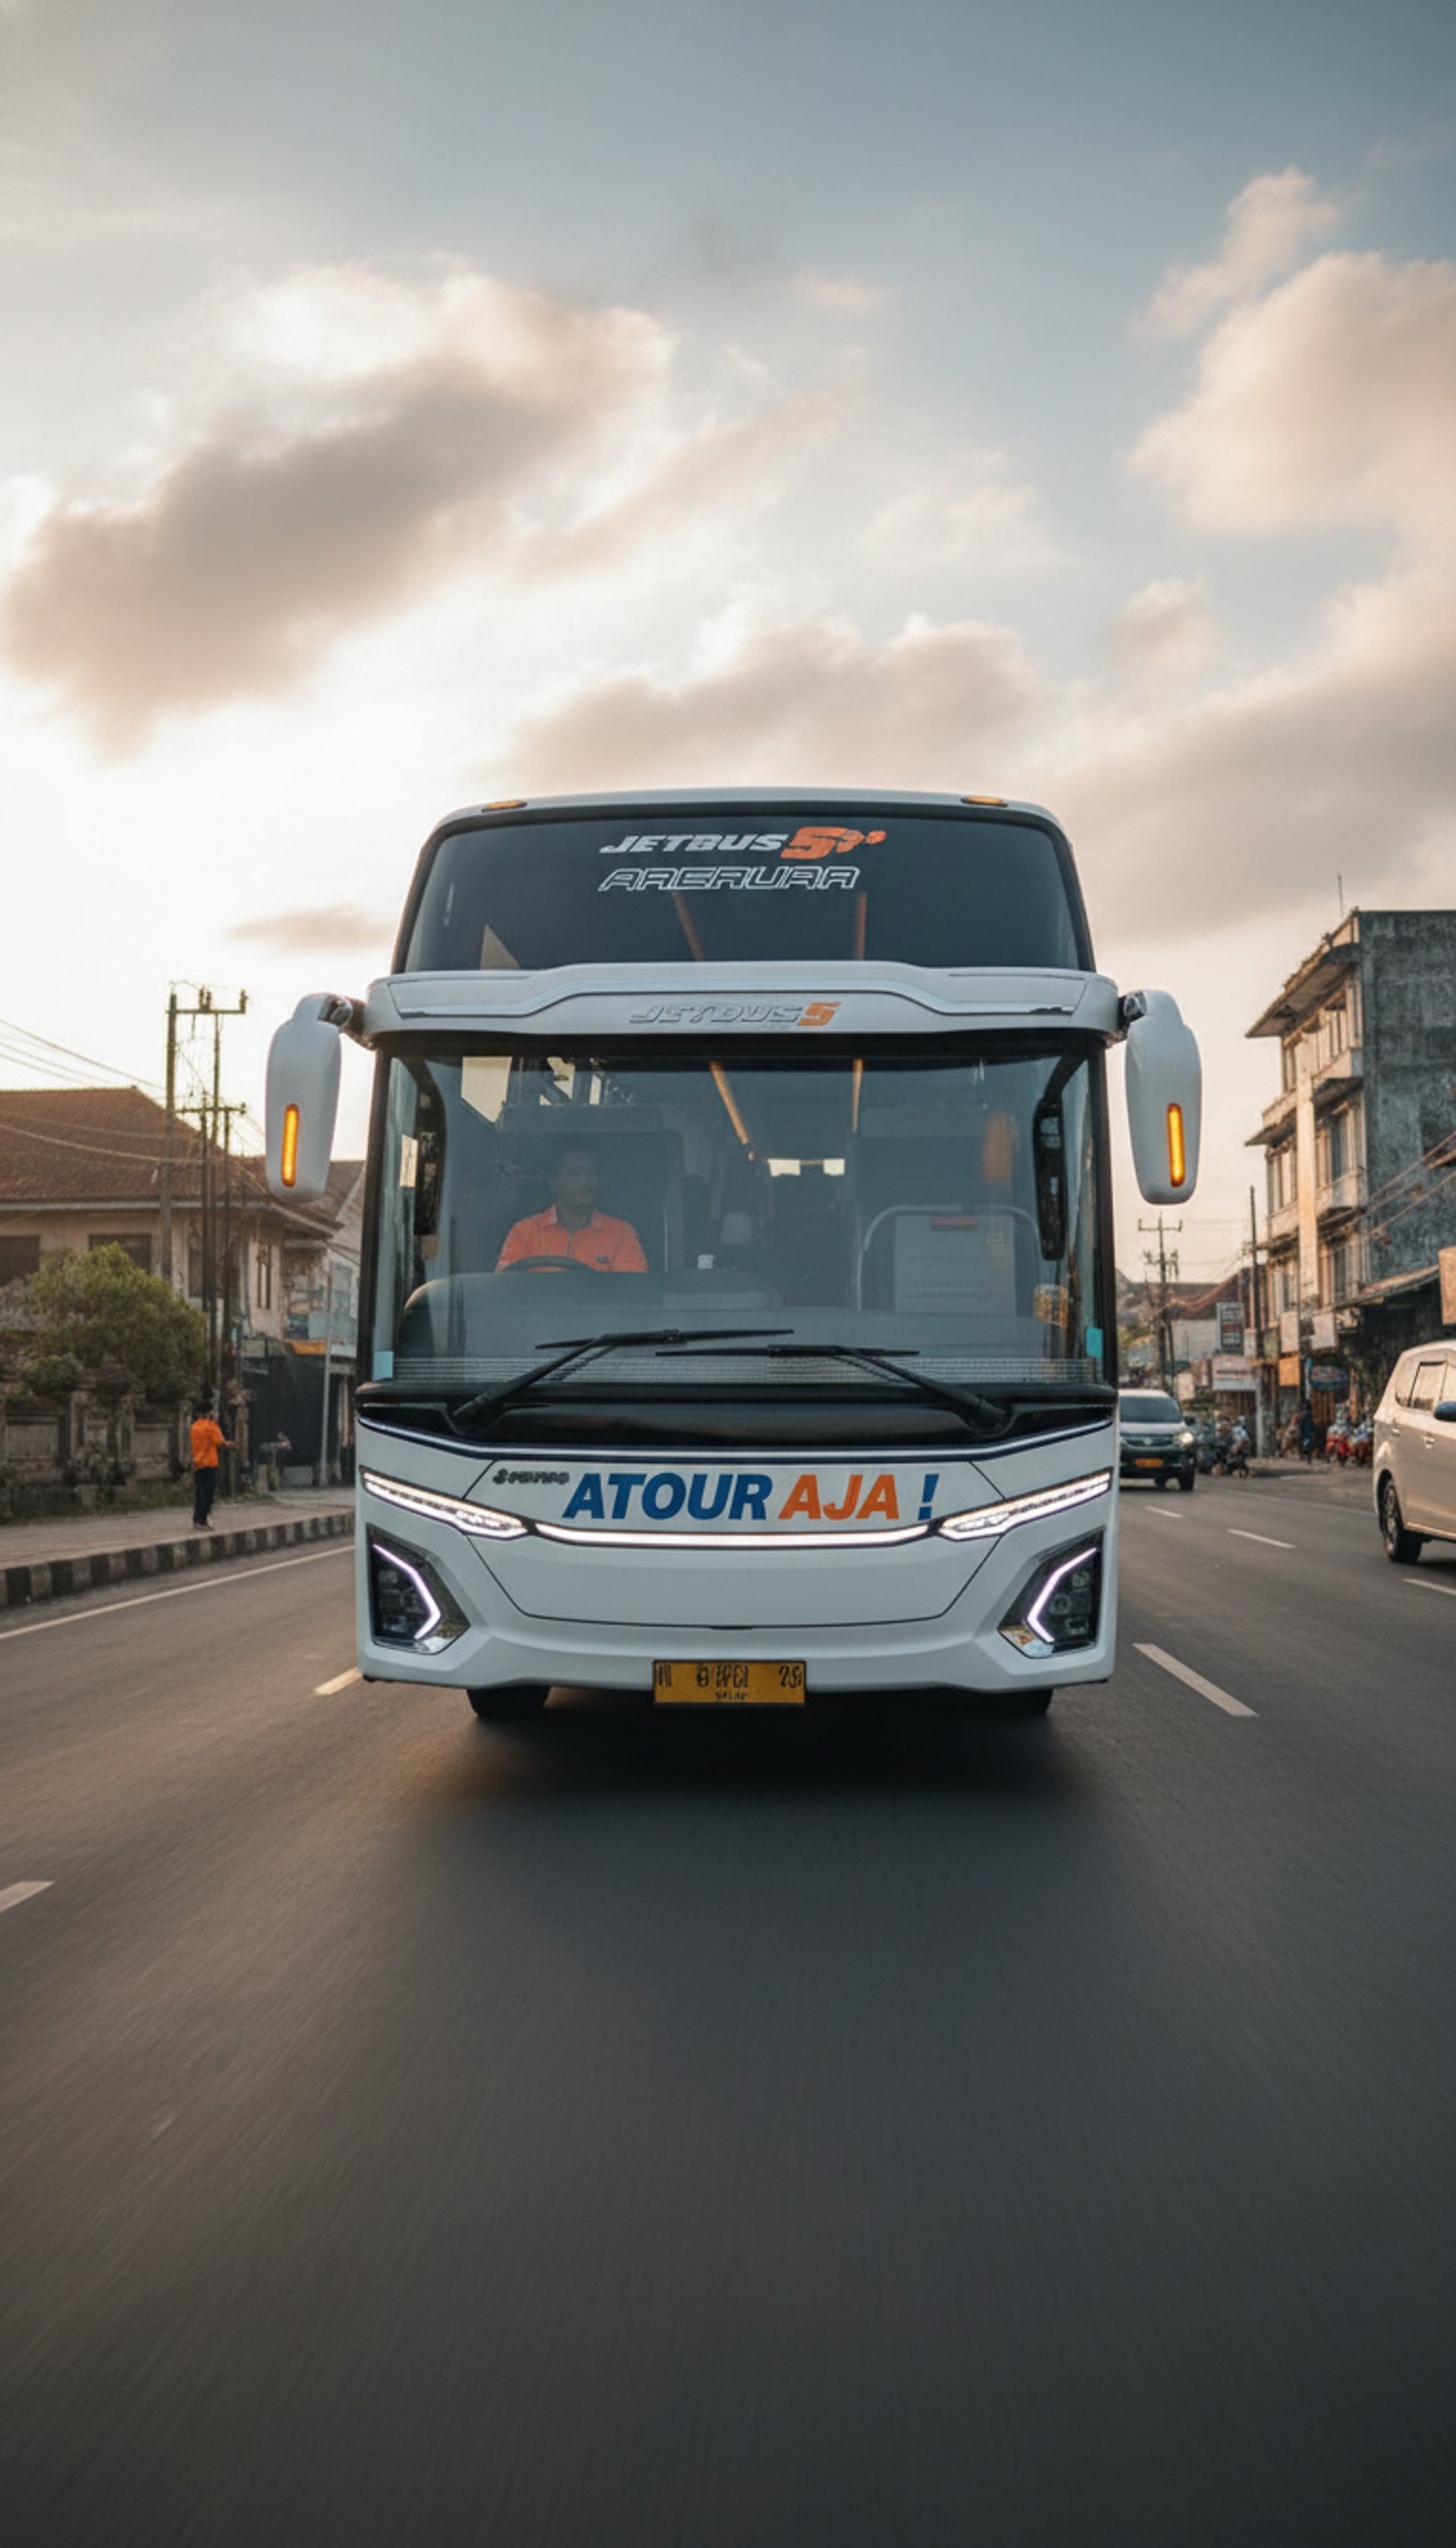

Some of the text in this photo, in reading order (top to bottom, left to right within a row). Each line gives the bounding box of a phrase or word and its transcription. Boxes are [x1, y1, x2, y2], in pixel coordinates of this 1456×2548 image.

[562, 1473, 940, 1520] ATOUR AJA !
